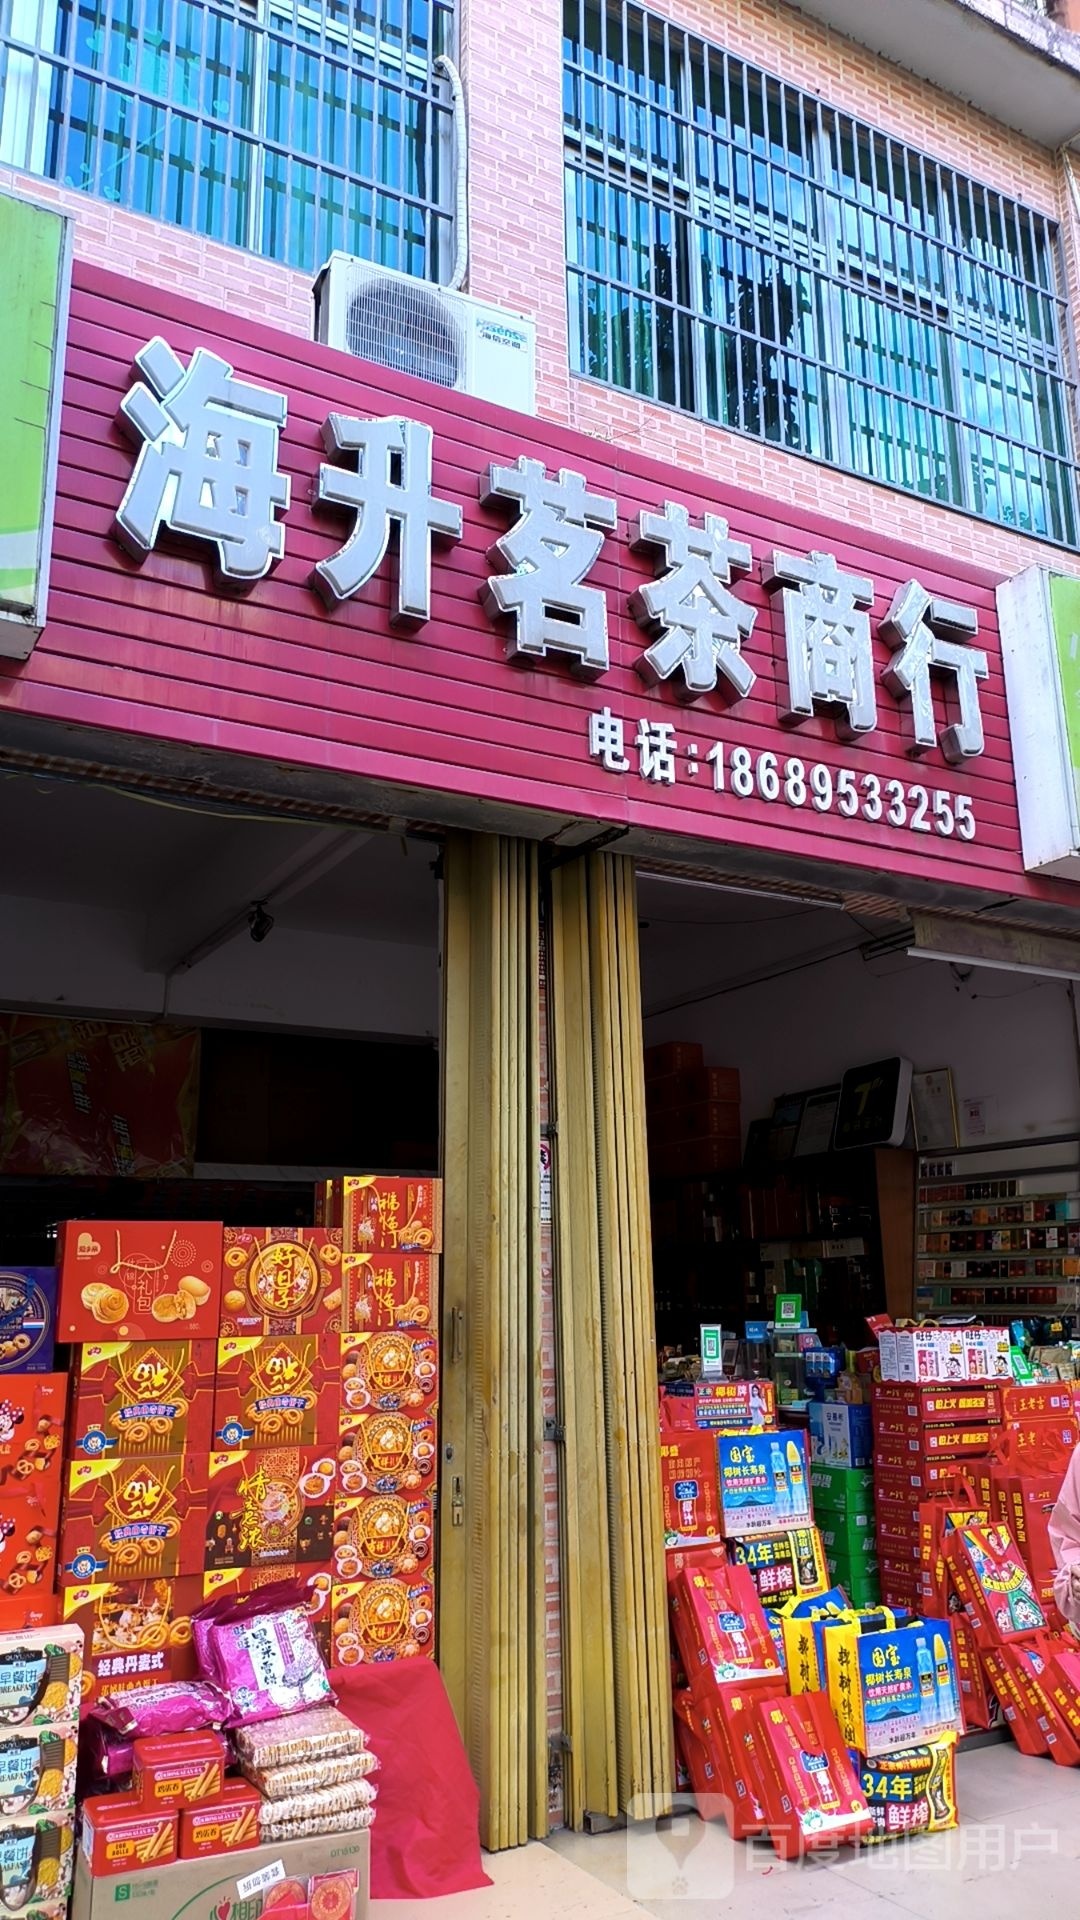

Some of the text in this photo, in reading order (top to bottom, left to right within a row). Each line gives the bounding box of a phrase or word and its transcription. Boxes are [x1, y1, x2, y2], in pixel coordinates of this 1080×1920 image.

[115, 336, 989, 760] 海升茗茶商行
[137, 1264, 152, 1311] 大礼包
[270, 1246, 297, 1309] 好日子
[1020, 1396, 1045, 1412] 王老吉
[723, 1464, 767, 1478] 椰树长寿泉
[759, 1566, 794, 1592] 鲜榨
[0, 1669, 38, 1684] 早餐饼
[97, 1652, 165, 1677] 经典丹麦式
[865, 1668, 912, 1686] 椰树长寿泉
[863, 1773, 912, 1800] 34年
[888, 1801, 929, 1829] 鲜榨
